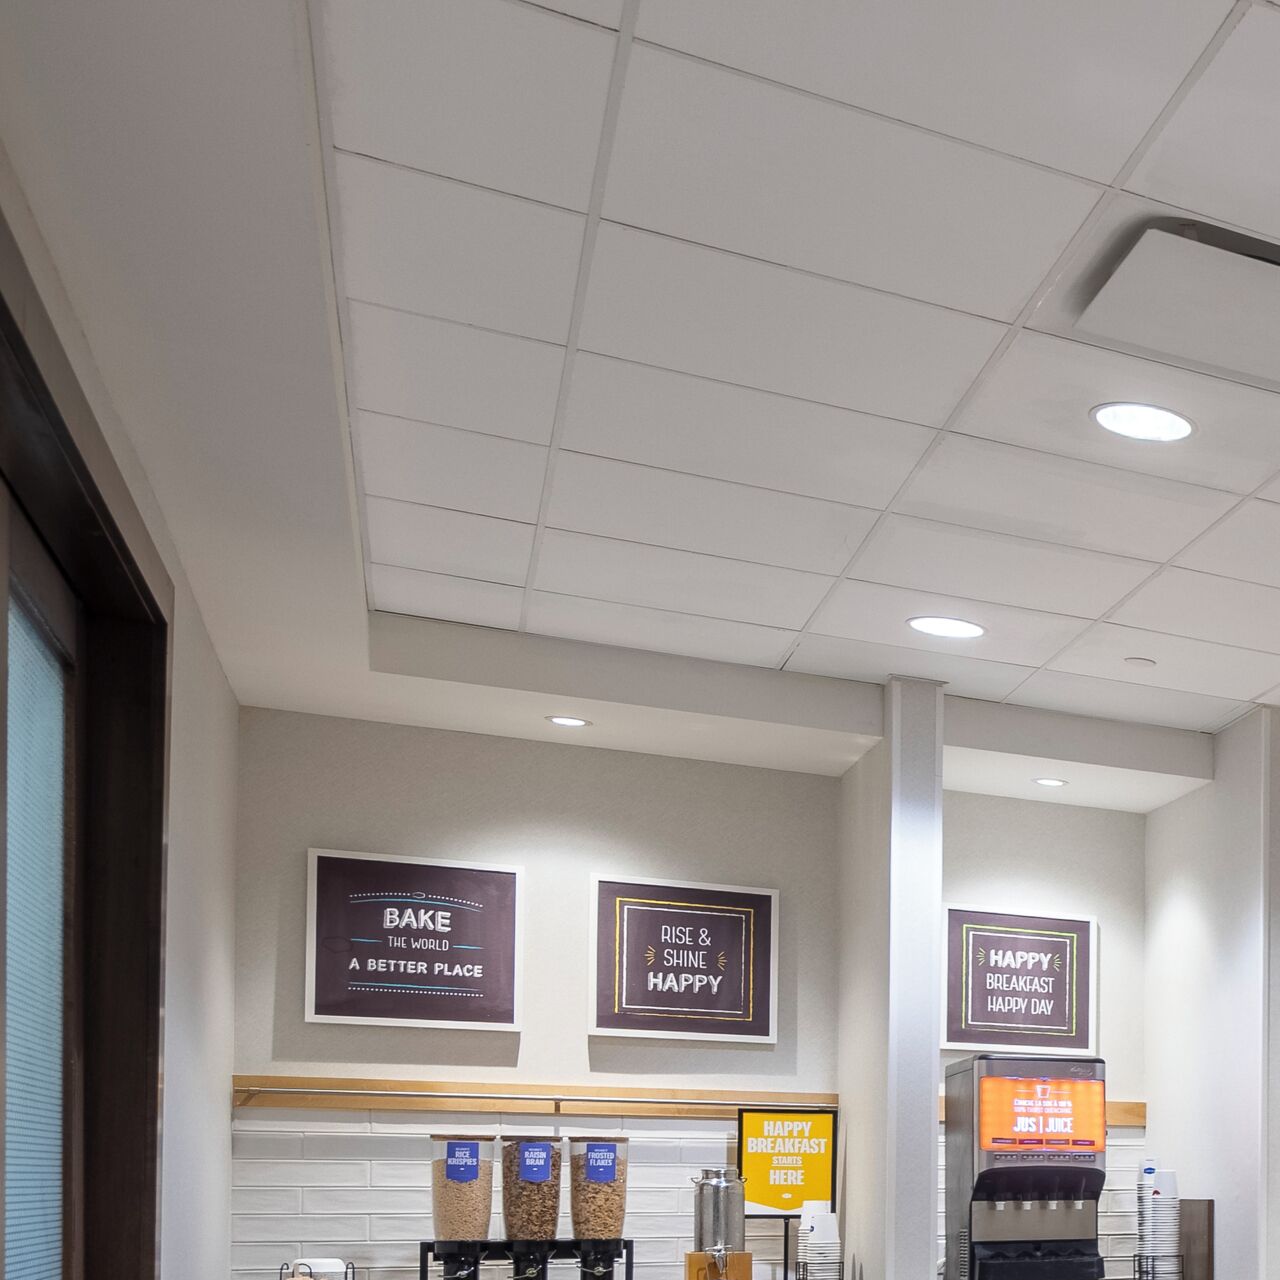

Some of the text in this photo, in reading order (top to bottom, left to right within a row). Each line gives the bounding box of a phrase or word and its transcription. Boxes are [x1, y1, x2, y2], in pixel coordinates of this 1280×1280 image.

[383, 907, 452, 932] BAKE
[388, 936, 449, 951] THE WORLD
[661, 925, 711, 946] RISE &
[348, 957, 484, 978] A BETTER PLACE
[663, 948, 707, 969] SHINE
[989, 949, 1052, 971] HAPPY
[647, 971, 723, 995] HAPPY
[986, 973, 1055, 993] BREAKFAST
[987, 995, 1054, 1015] HAPPY DAY
[763, 1120, 812, 1137] HAPPY
[1013, 1116, 1074, 1133] JUS JUICE
[747, 1137, 827, 1154] BREAKFAST
[525, 1158, 545, 1166] BRAN
[588, 1152, 615, 1160] FROSTED
[771, 1155, 803, 1165] STARTS
[769, 1169, 805, 1185] HERE
